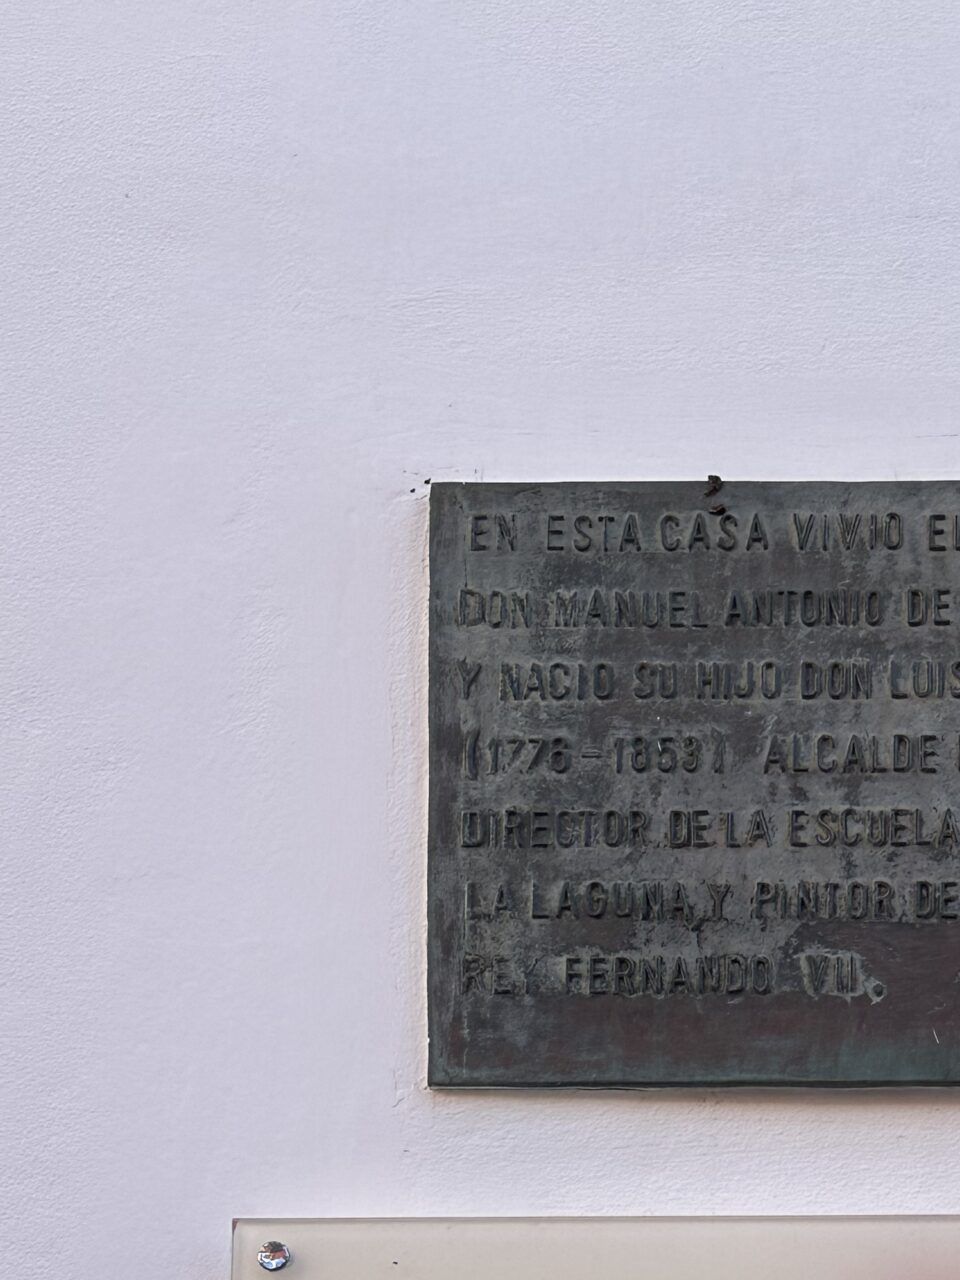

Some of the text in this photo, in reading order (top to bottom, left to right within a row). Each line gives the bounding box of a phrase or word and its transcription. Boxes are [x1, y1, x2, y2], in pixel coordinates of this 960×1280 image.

[469, 512, 518, 552] EN
[545, 513, 642, 553] ESTA
[658, 511, 771, 553] CASA
[792, 512, 904, 554] VIVIO
[456, 588, 533, 631] DON
[552, 588, 709, 630] MANUEL
[723, 588, 887, 629] ANTONIO
[905, 588, 951, 627] DE
[457, 660, 482, 702] Y
[499, 660, 616, 702] NACIO
[633, 660, 678, 701] SU
[696, 660, 784, 701] HIJO
[800, 660, 875, 701] DON
[763, 735, 939, 775] ALCALDE
[461, 808, 652, 848] DIRECTOR
[668, 808, 710, 849] DE
[725, 808, 773, 848] LA
[788, 808, 960, 848] ESCUELA
[463, 881, 509, 920] LA
[706, 882, 733, 919] Y
[752, 881, 897, 920] PINTOR
[915, 881, 959, 920] DE
[562, 954, 774, 996] FERNANDO
